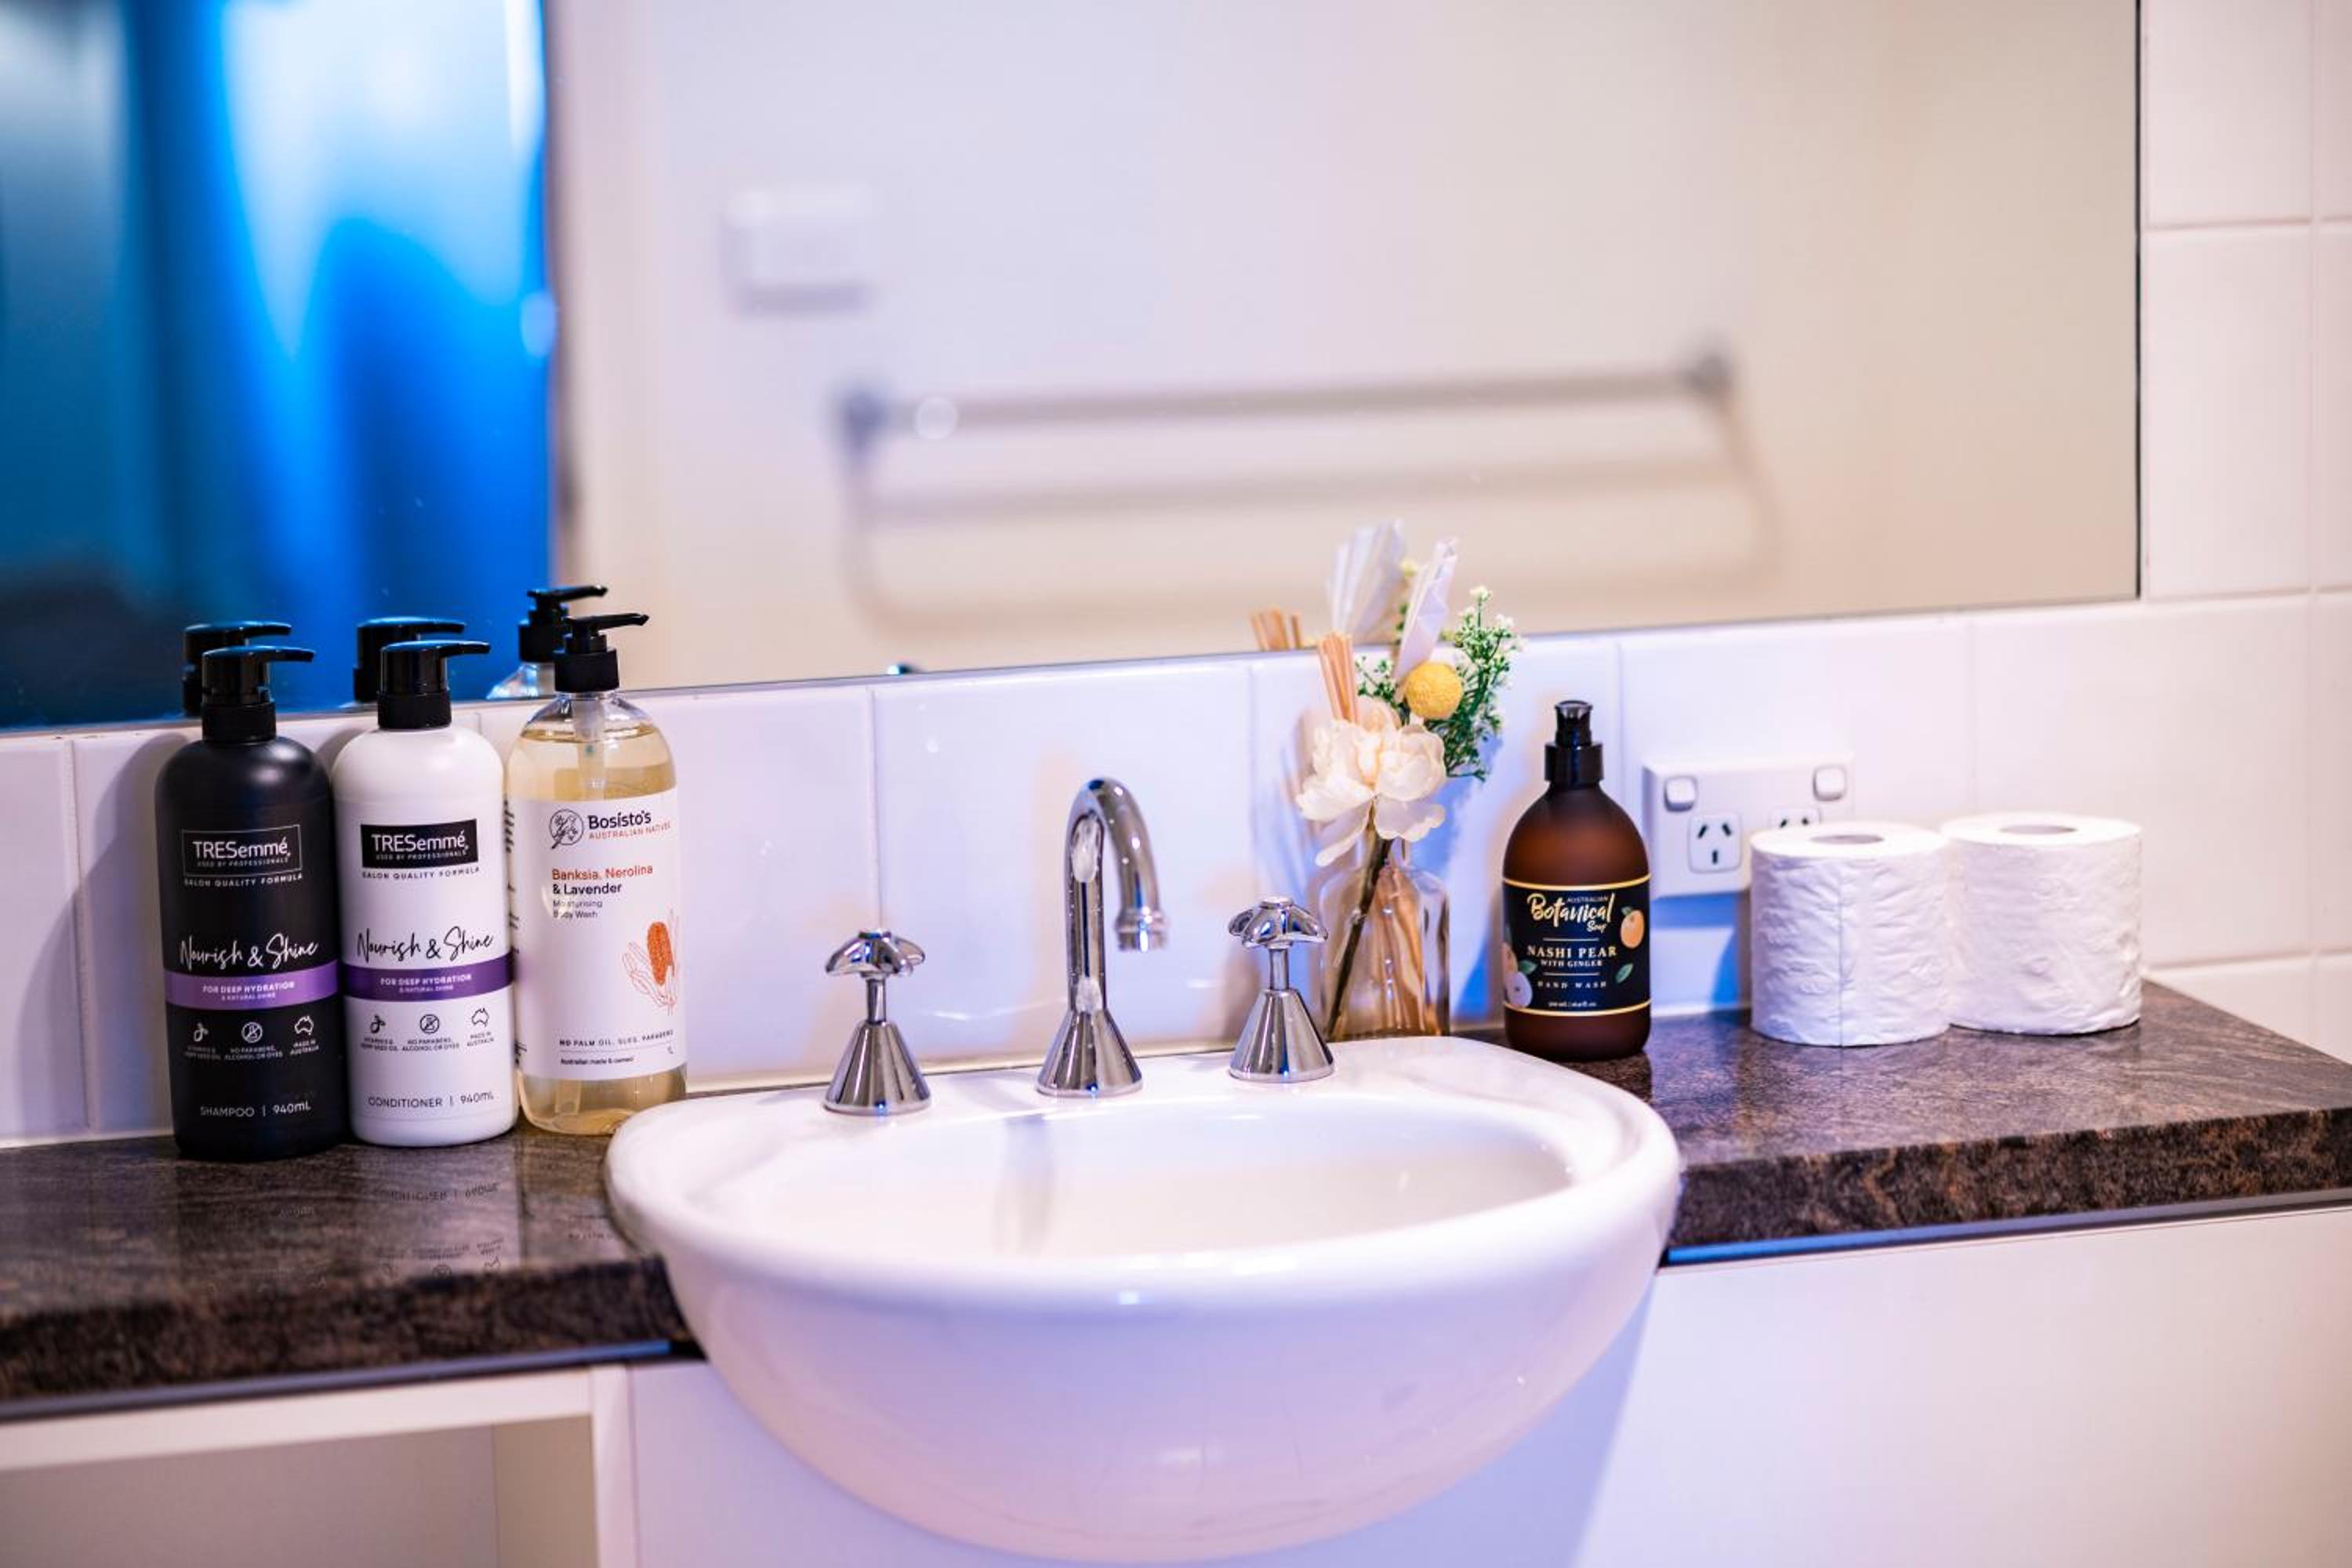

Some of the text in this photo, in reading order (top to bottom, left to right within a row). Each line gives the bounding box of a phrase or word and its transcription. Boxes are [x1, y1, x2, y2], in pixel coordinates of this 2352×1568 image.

[588, 810, 652, 830] Bosisto's
[589, 828, 644, 840] AUSTRALIAN
[393, 871, 434, 880] QUALITY
[439, 866, 479, 878] FORMULA
[605, 865, 654, 878] Nerolina
[215, 878, 256, 887] QUALITY
[260, 872, 303, 885] FORMULA
[553, 883, 622, 895] & Lavender
[553, 910, 573, 920] Bdy
[1526, 892, 1616, 927] Botanical
[1586, 920, 1606, 933] Soap
[179, 932, 319, 971] Nourish & Shine
[356, 926, 494, 964] Nourish & Shine
[1527, 946, 1617, 959] NASHI PEAR
[422, 974, 473, 985] HYDRATION
[202, 981, 296, 993] FOR DEEP HYDRATION
[368, 1096, 443, 1109] CONDITIONER
[200, 1105, 255, 1117] SHAMPOO
